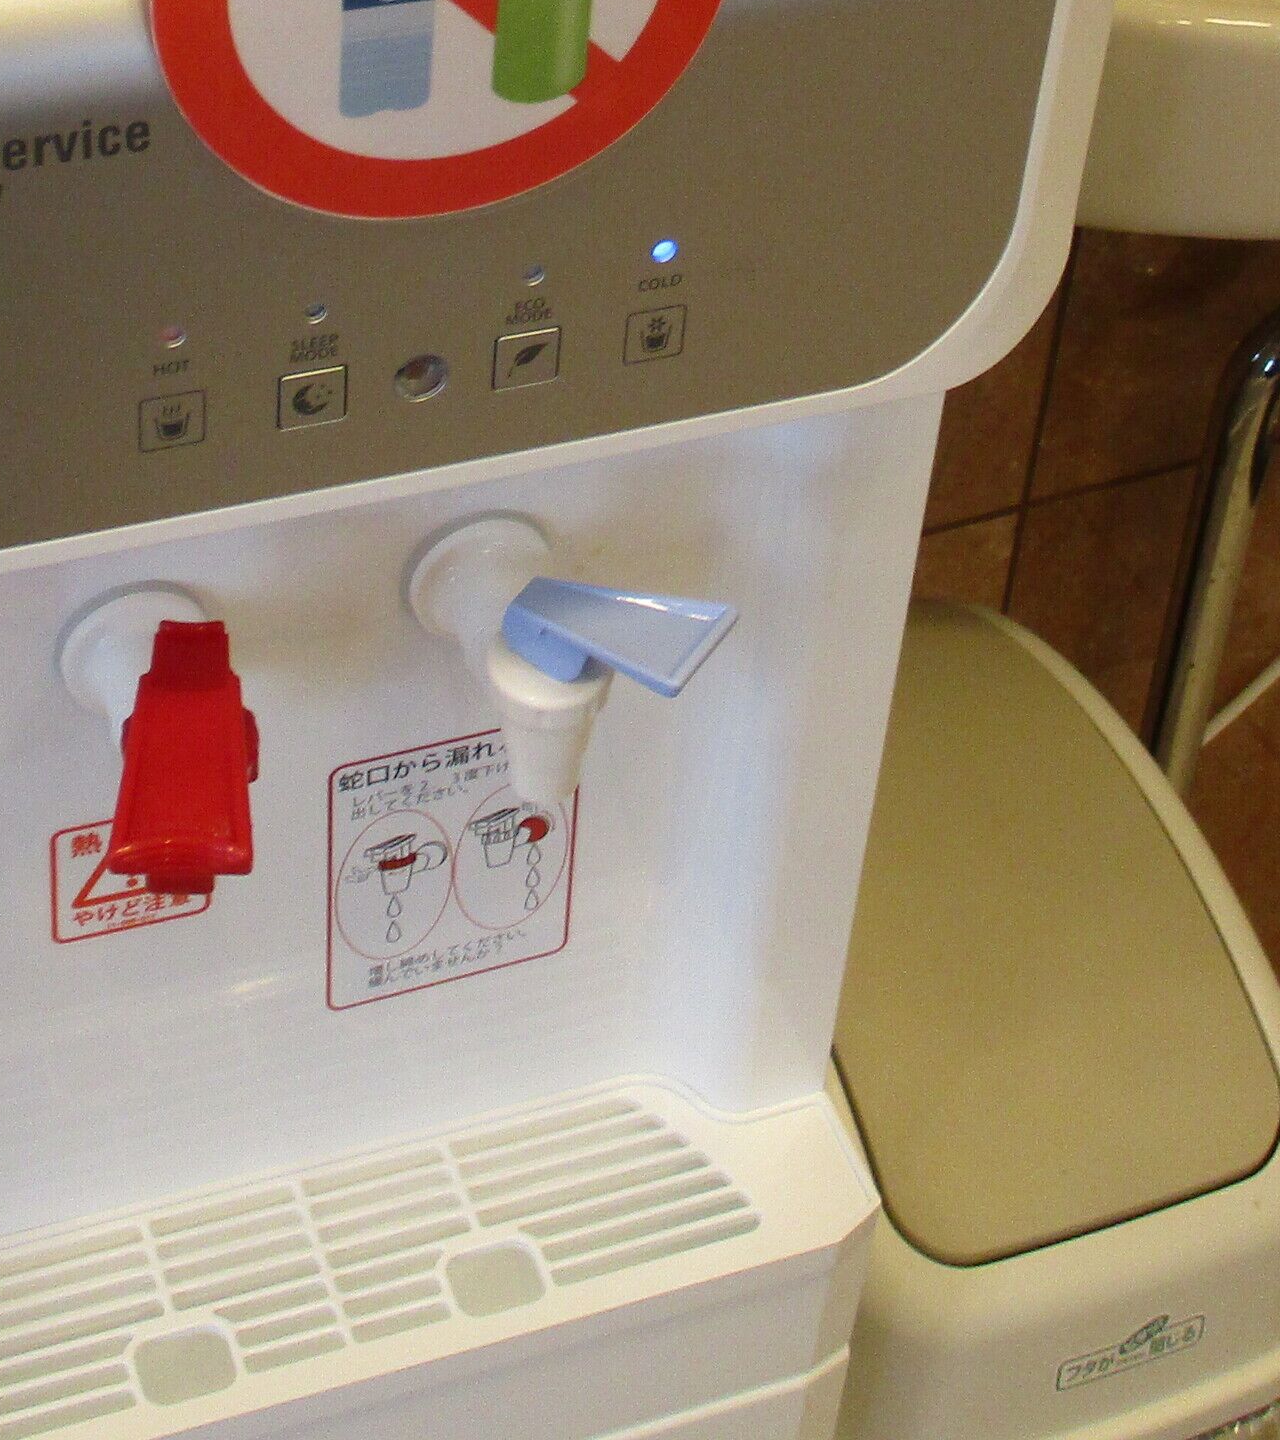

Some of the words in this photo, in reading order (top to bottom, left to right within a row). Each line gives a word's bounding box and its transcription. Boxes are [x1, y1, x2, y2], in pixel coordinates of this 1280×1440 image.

[637, 272, 684, 292] COLD
[152, 358, 191, 378] HOT
[338, 741, 506, 793] 蛇口から漏れ
